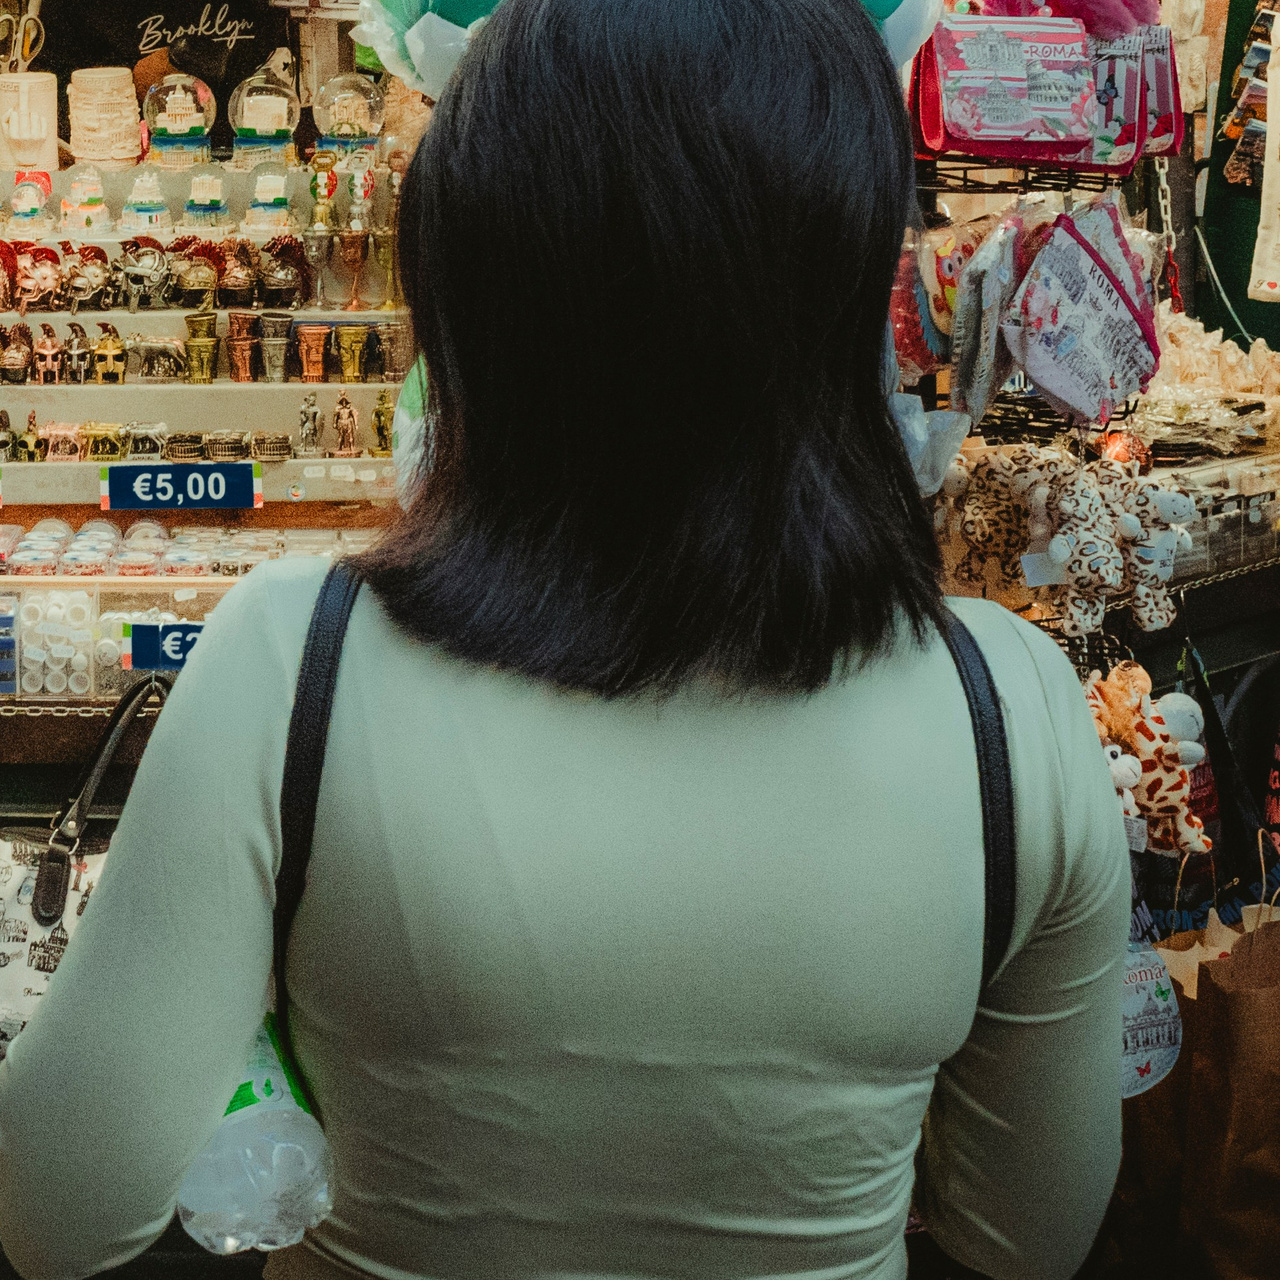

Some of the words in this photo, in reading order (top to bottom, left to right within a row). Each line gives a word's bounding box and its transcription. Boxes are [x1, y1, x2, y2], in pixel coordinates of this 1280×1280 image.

[137, 3, 255, 54] Brooklyn
[1089, 263, 1120, 312] ROMA
[132, 471, 226, 505] €5,00
